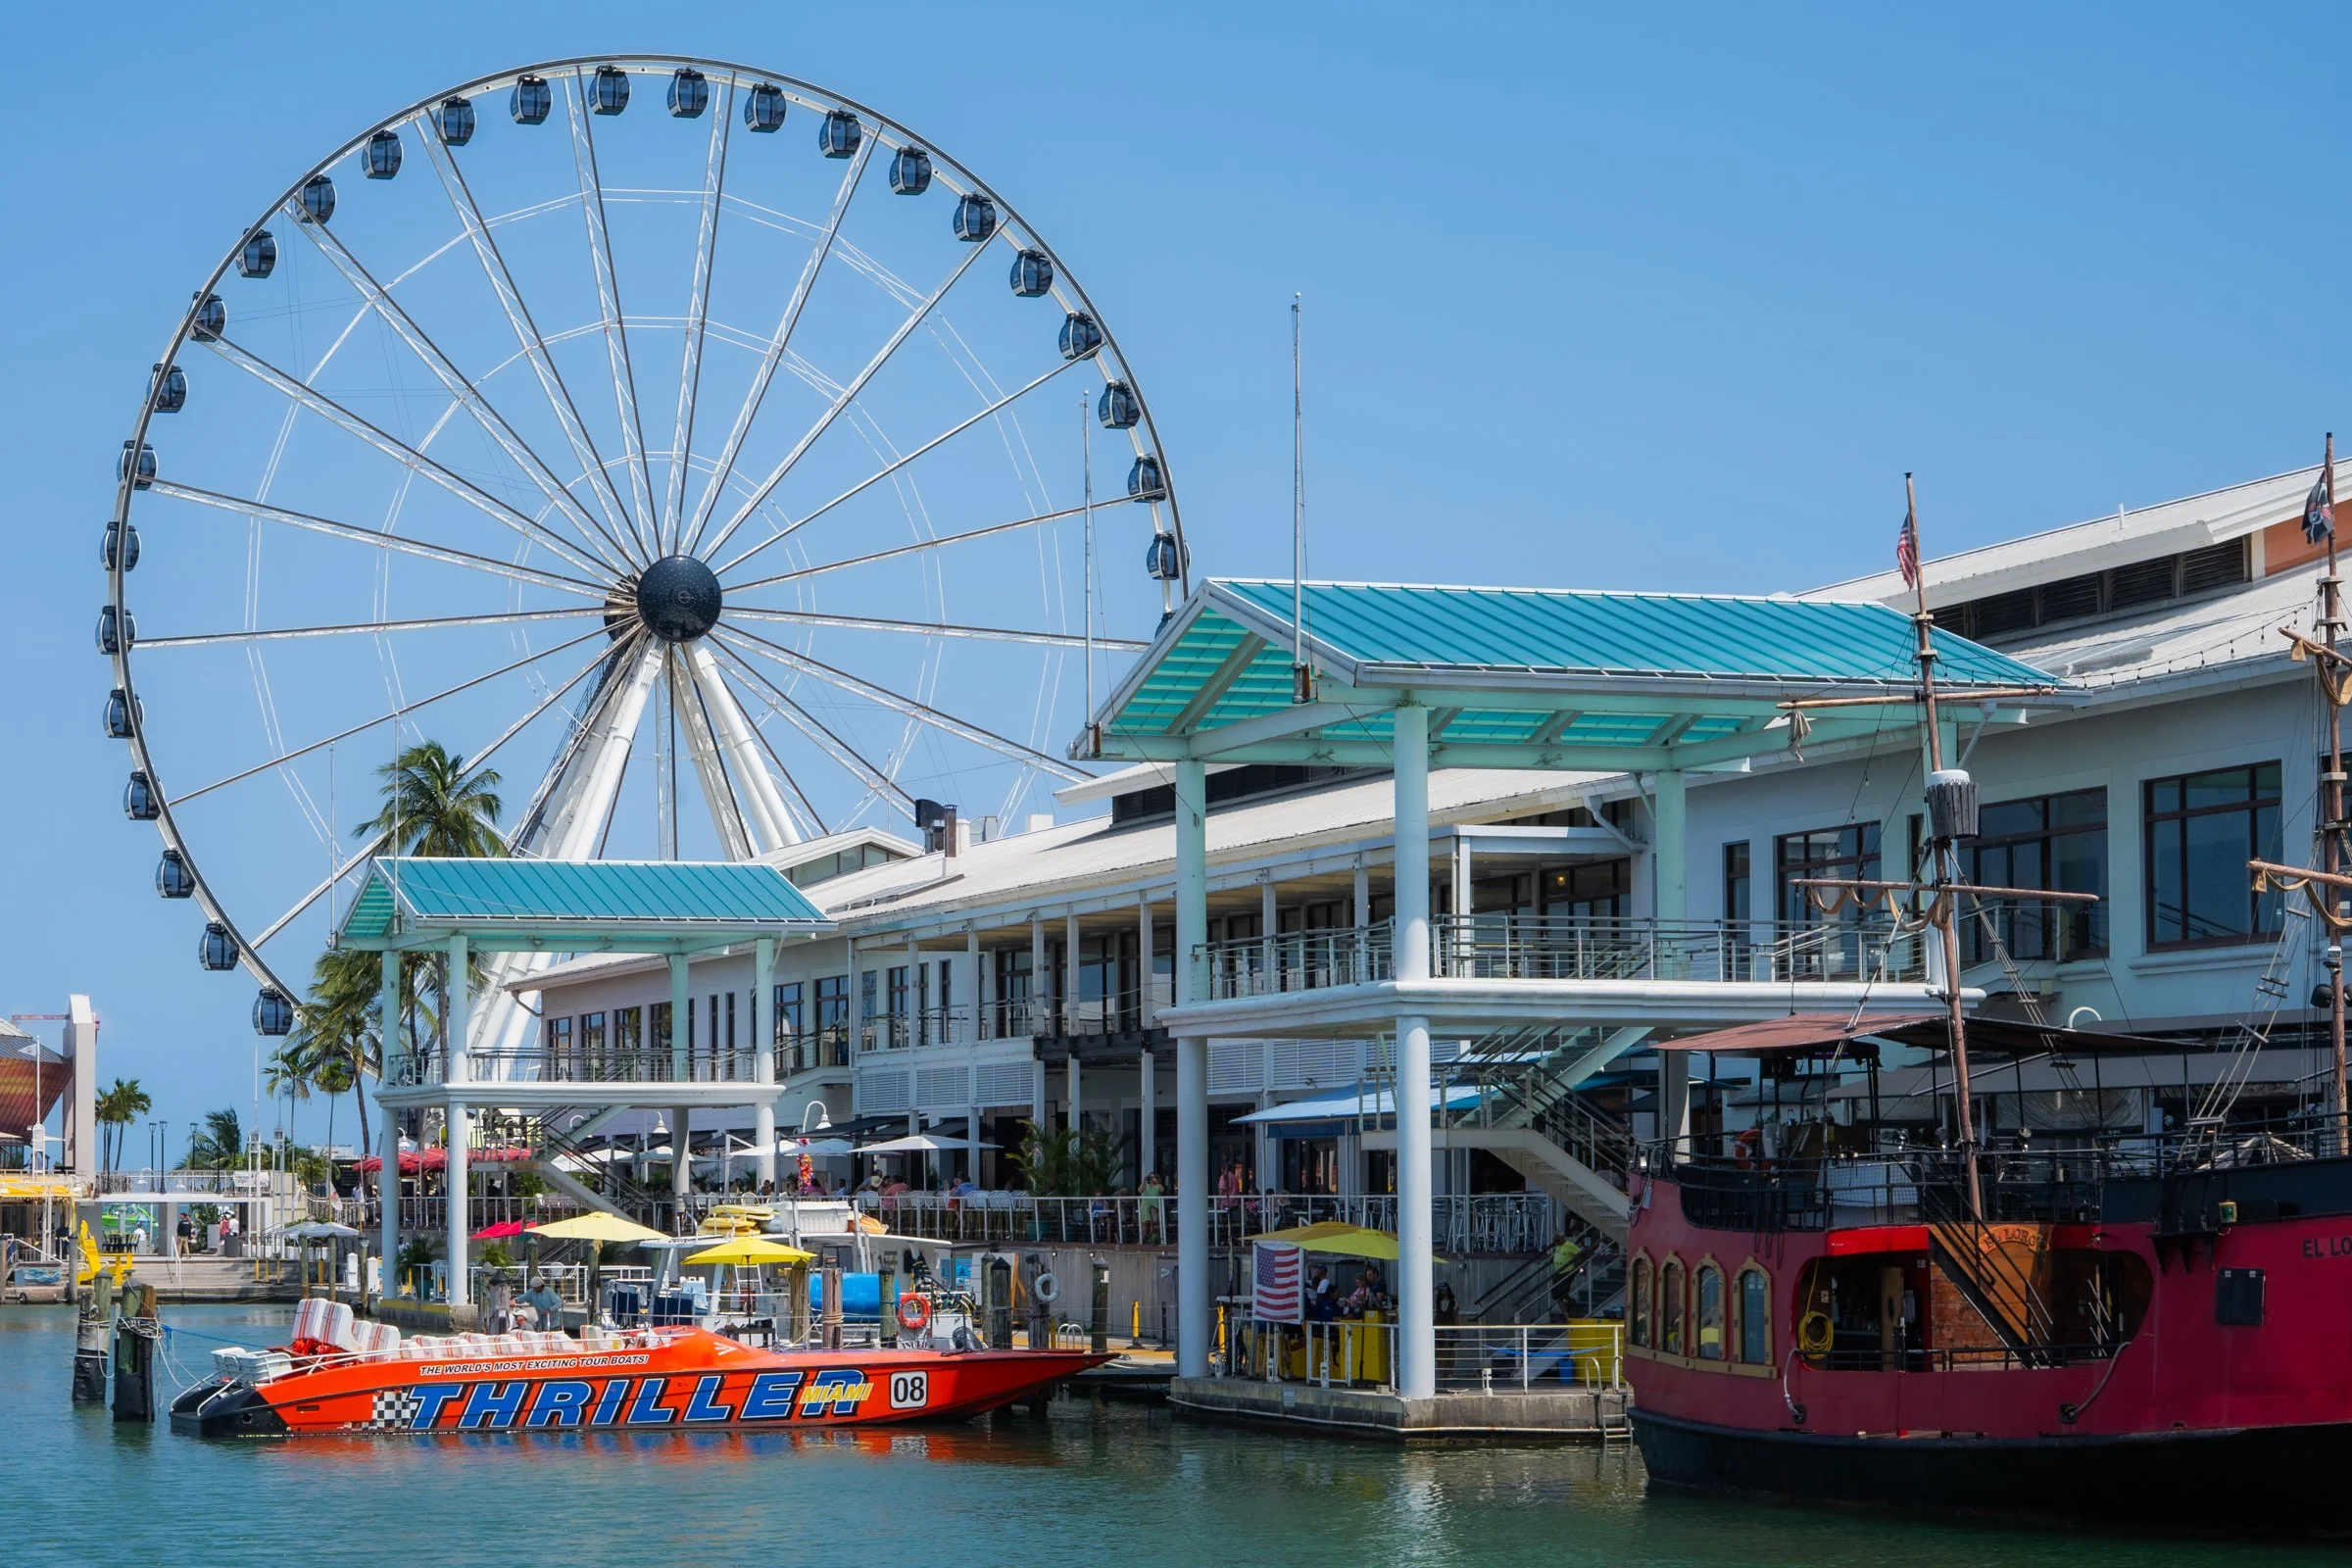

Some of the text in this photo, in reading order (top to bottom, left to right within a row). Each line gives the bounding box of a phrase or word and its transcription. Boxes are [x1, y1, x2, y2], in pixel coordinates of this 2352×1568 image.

[2004, 1228, 2035, 1247] LORO
[2303, 1239, 2325, 1257] EL
[420, 1354, 649, 1376] THE WORLD'S MOST EXCITING TOUR BOATS!
[409, 1369, 866, 1430] THRILLER
[800, 1383, 874, 1403] MIAMI
[893, 1376, 925, 1402] 08
